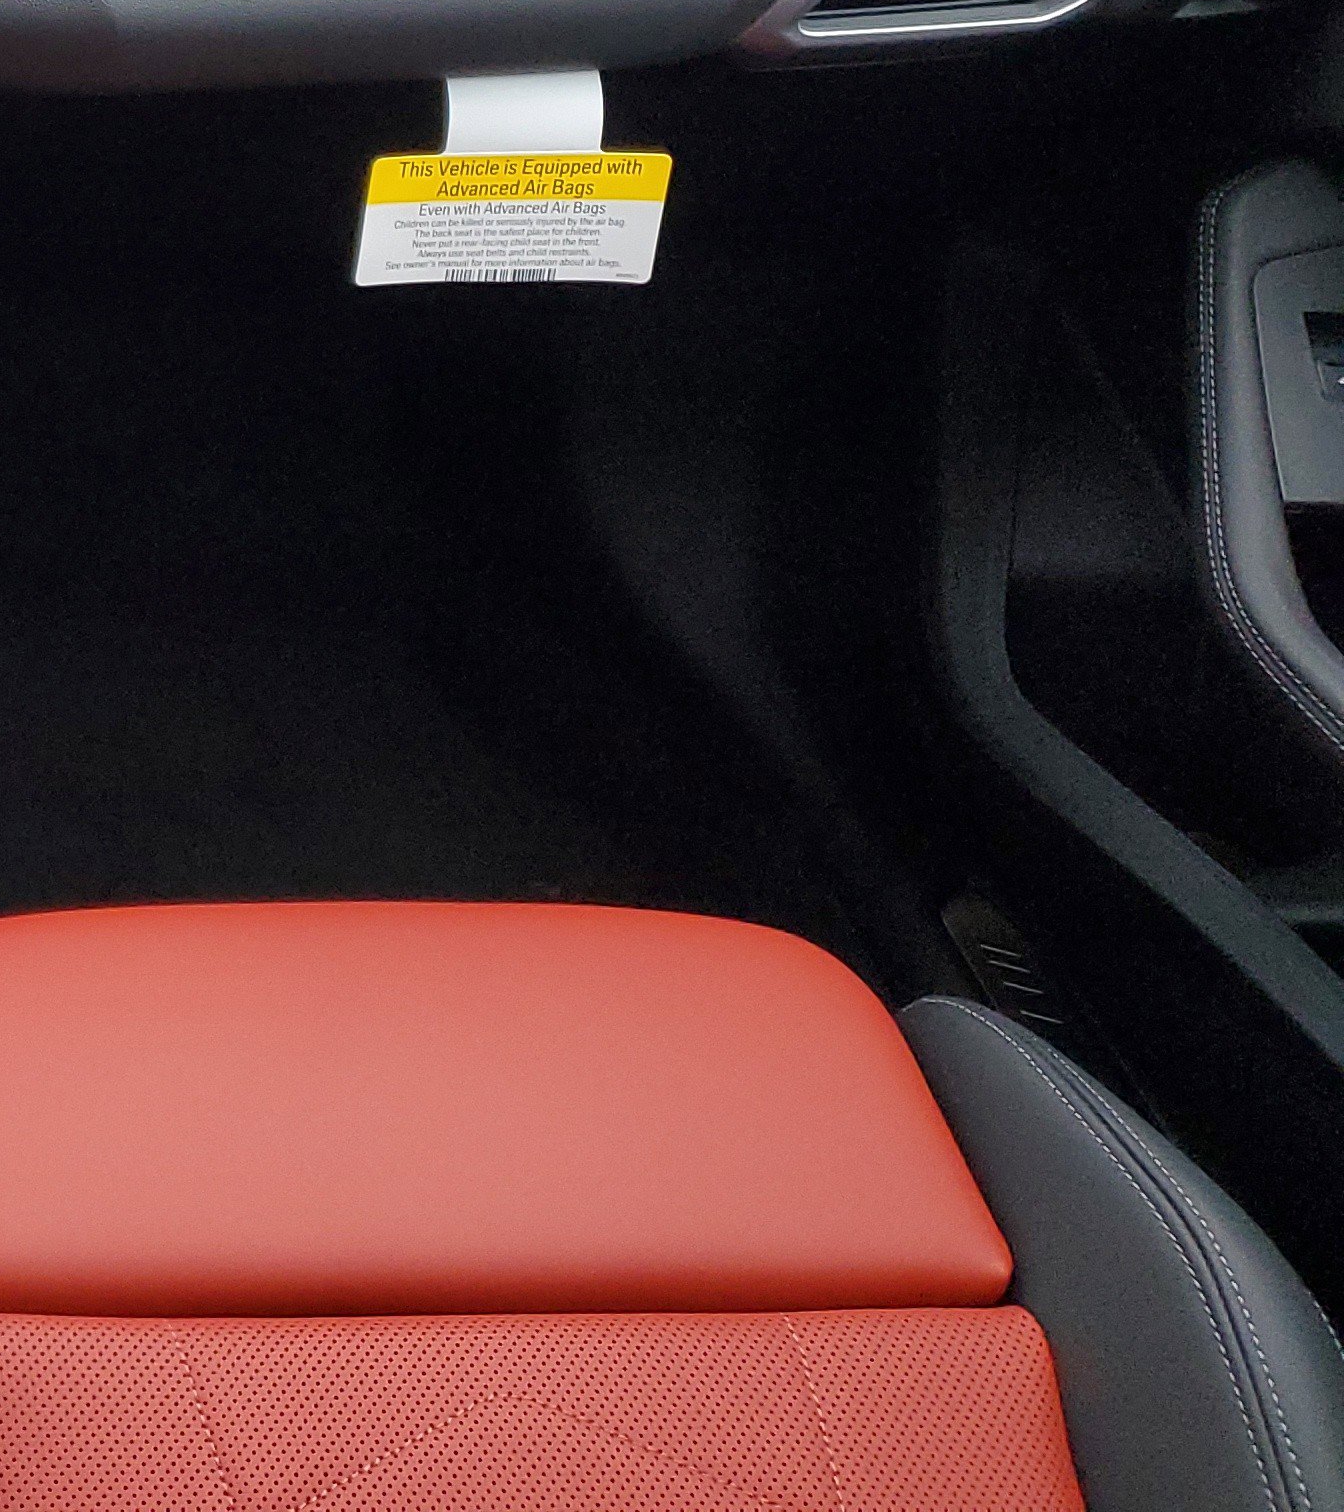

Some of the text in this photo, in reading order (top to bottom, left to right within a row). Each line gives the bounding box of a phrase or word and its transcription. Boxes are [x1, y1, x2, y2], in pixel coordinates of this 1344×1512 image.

[400, 158, 643, 178] This Vehicle is Equipped with
[436, 178, 595, 199] Advanced Air Bags
[419, 201, 607, 217] Even with Advanced Air Bags
[394, 220, 430, 230] Children
[448, 219, 460, 228] be
[415, 229, 430, 238] The
[432, 228, 452, 238] back
